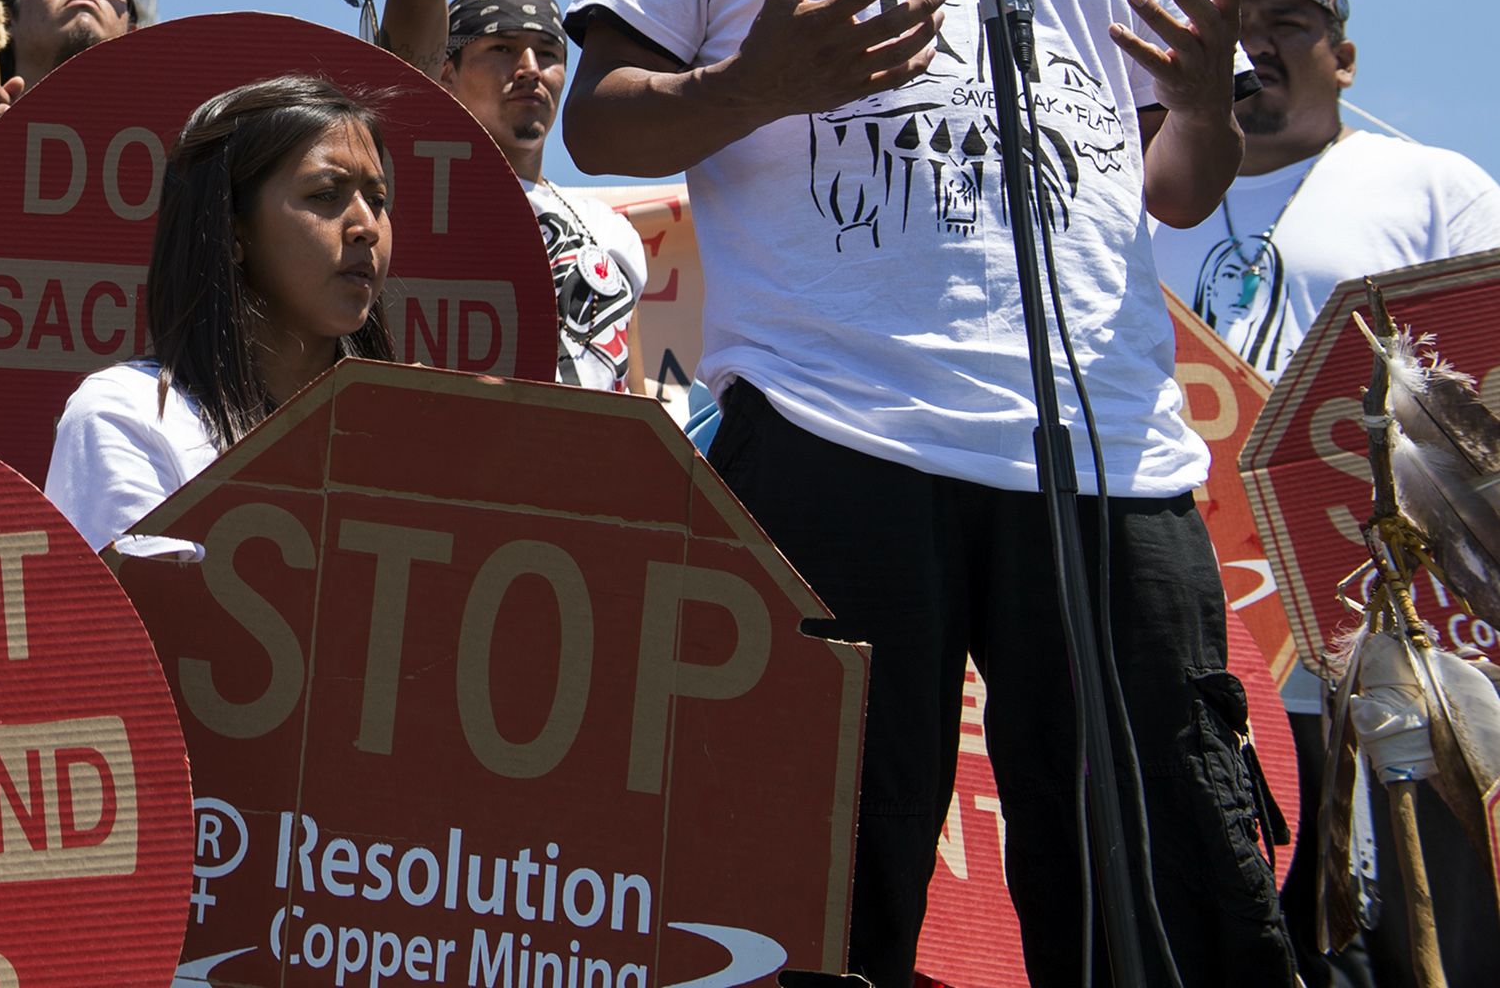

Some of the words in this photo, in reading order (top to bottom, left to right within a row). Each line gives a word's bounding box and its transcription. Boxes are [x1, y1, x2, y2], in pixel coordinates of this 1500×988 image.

[951, 87, 996, 109] SAVE
[1073, 104, 1116, 135] FLAT
[23, 122, 167, 221] DO
[404, 296, 503, 374] ND
[178, 502, 773, 795] STOP
[275, 811, 652, 935] Resolution
[269, 905, 455, 988] Copper
[468, 929, 648, 988] Mining
